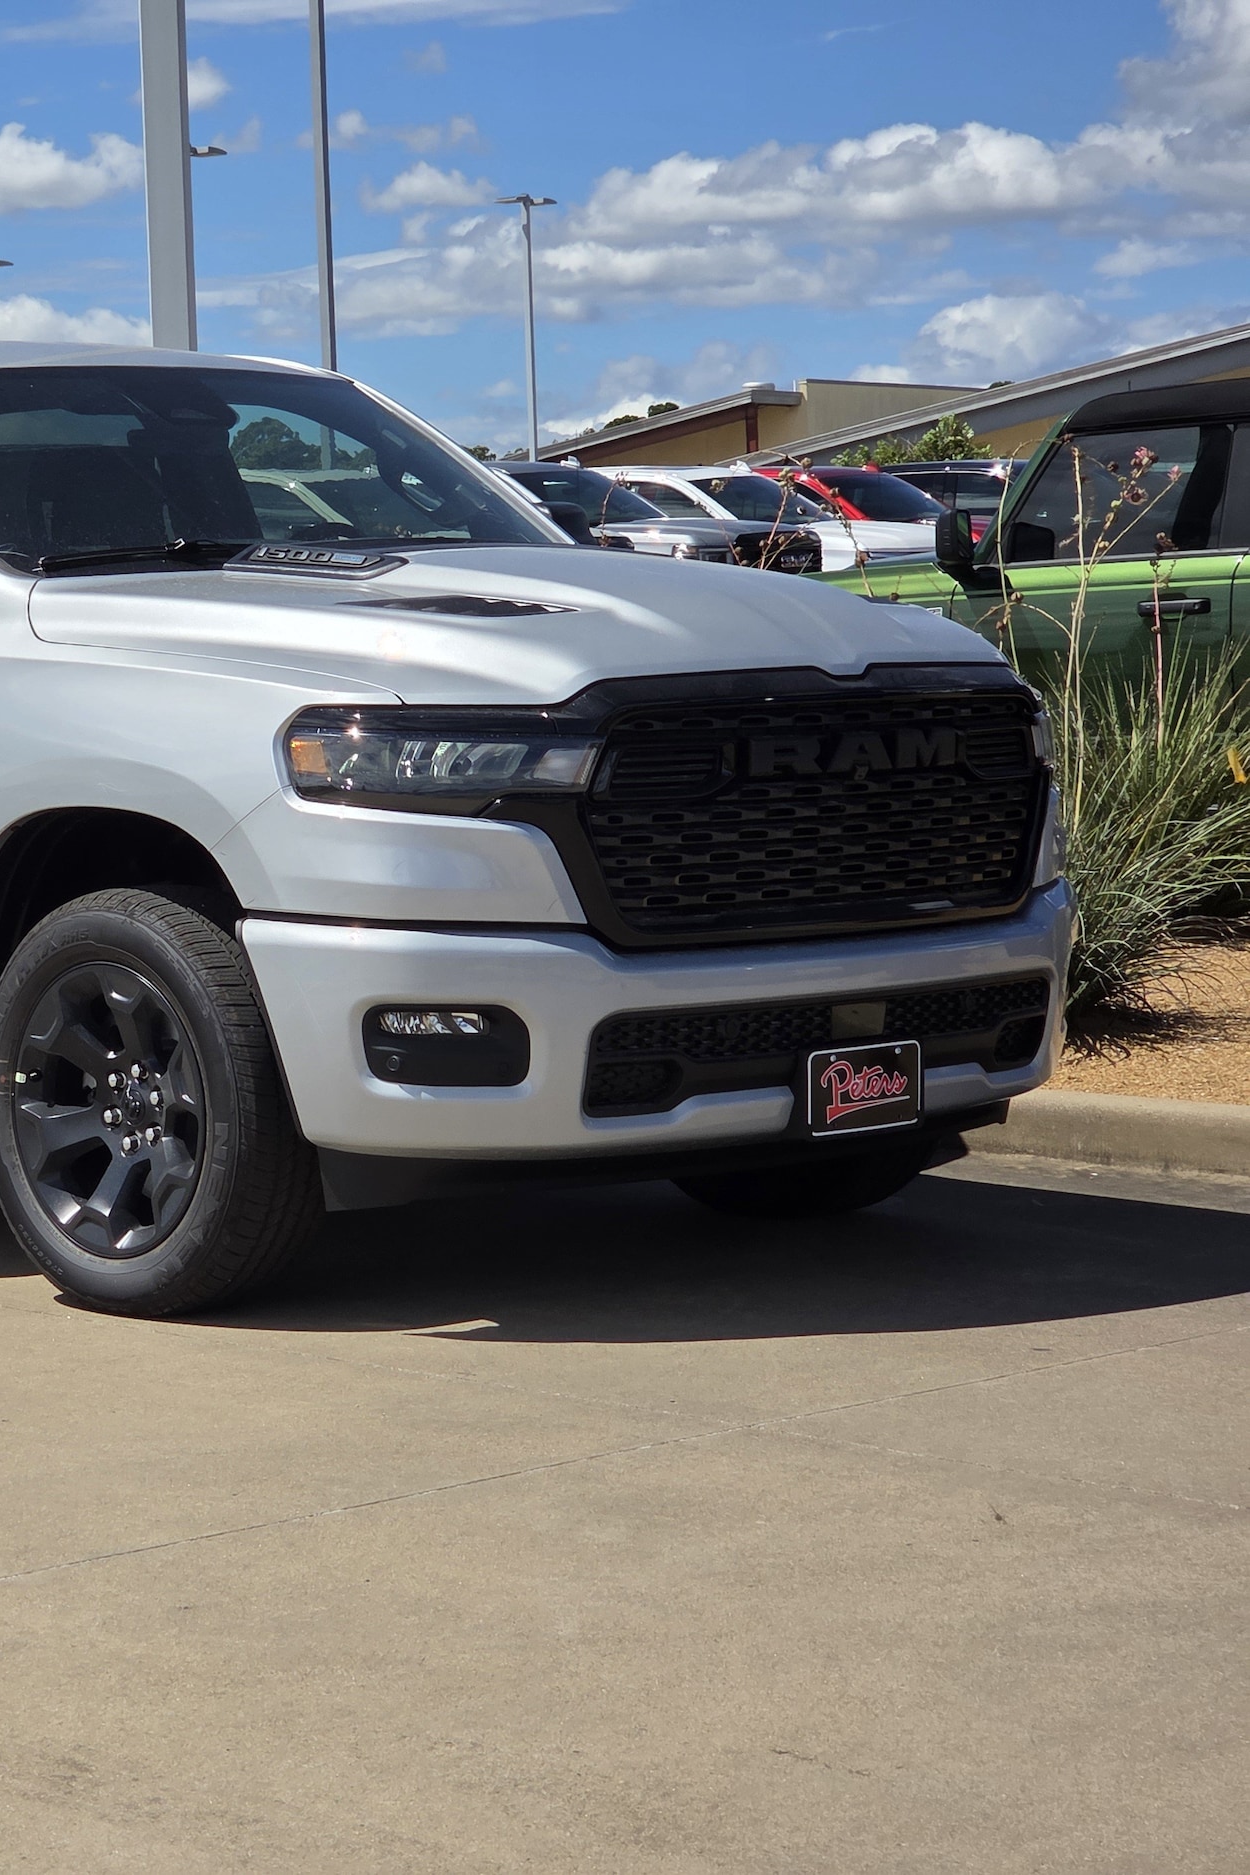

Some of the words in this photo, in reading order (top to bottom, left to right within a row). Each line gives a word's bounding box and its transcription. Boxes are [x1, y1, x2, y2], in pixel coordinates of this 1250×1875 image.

[257, 545, 332, 562] 1500
[750, 726, 956, 776] RAM
[820, 1060, 908, 1107] Peters
